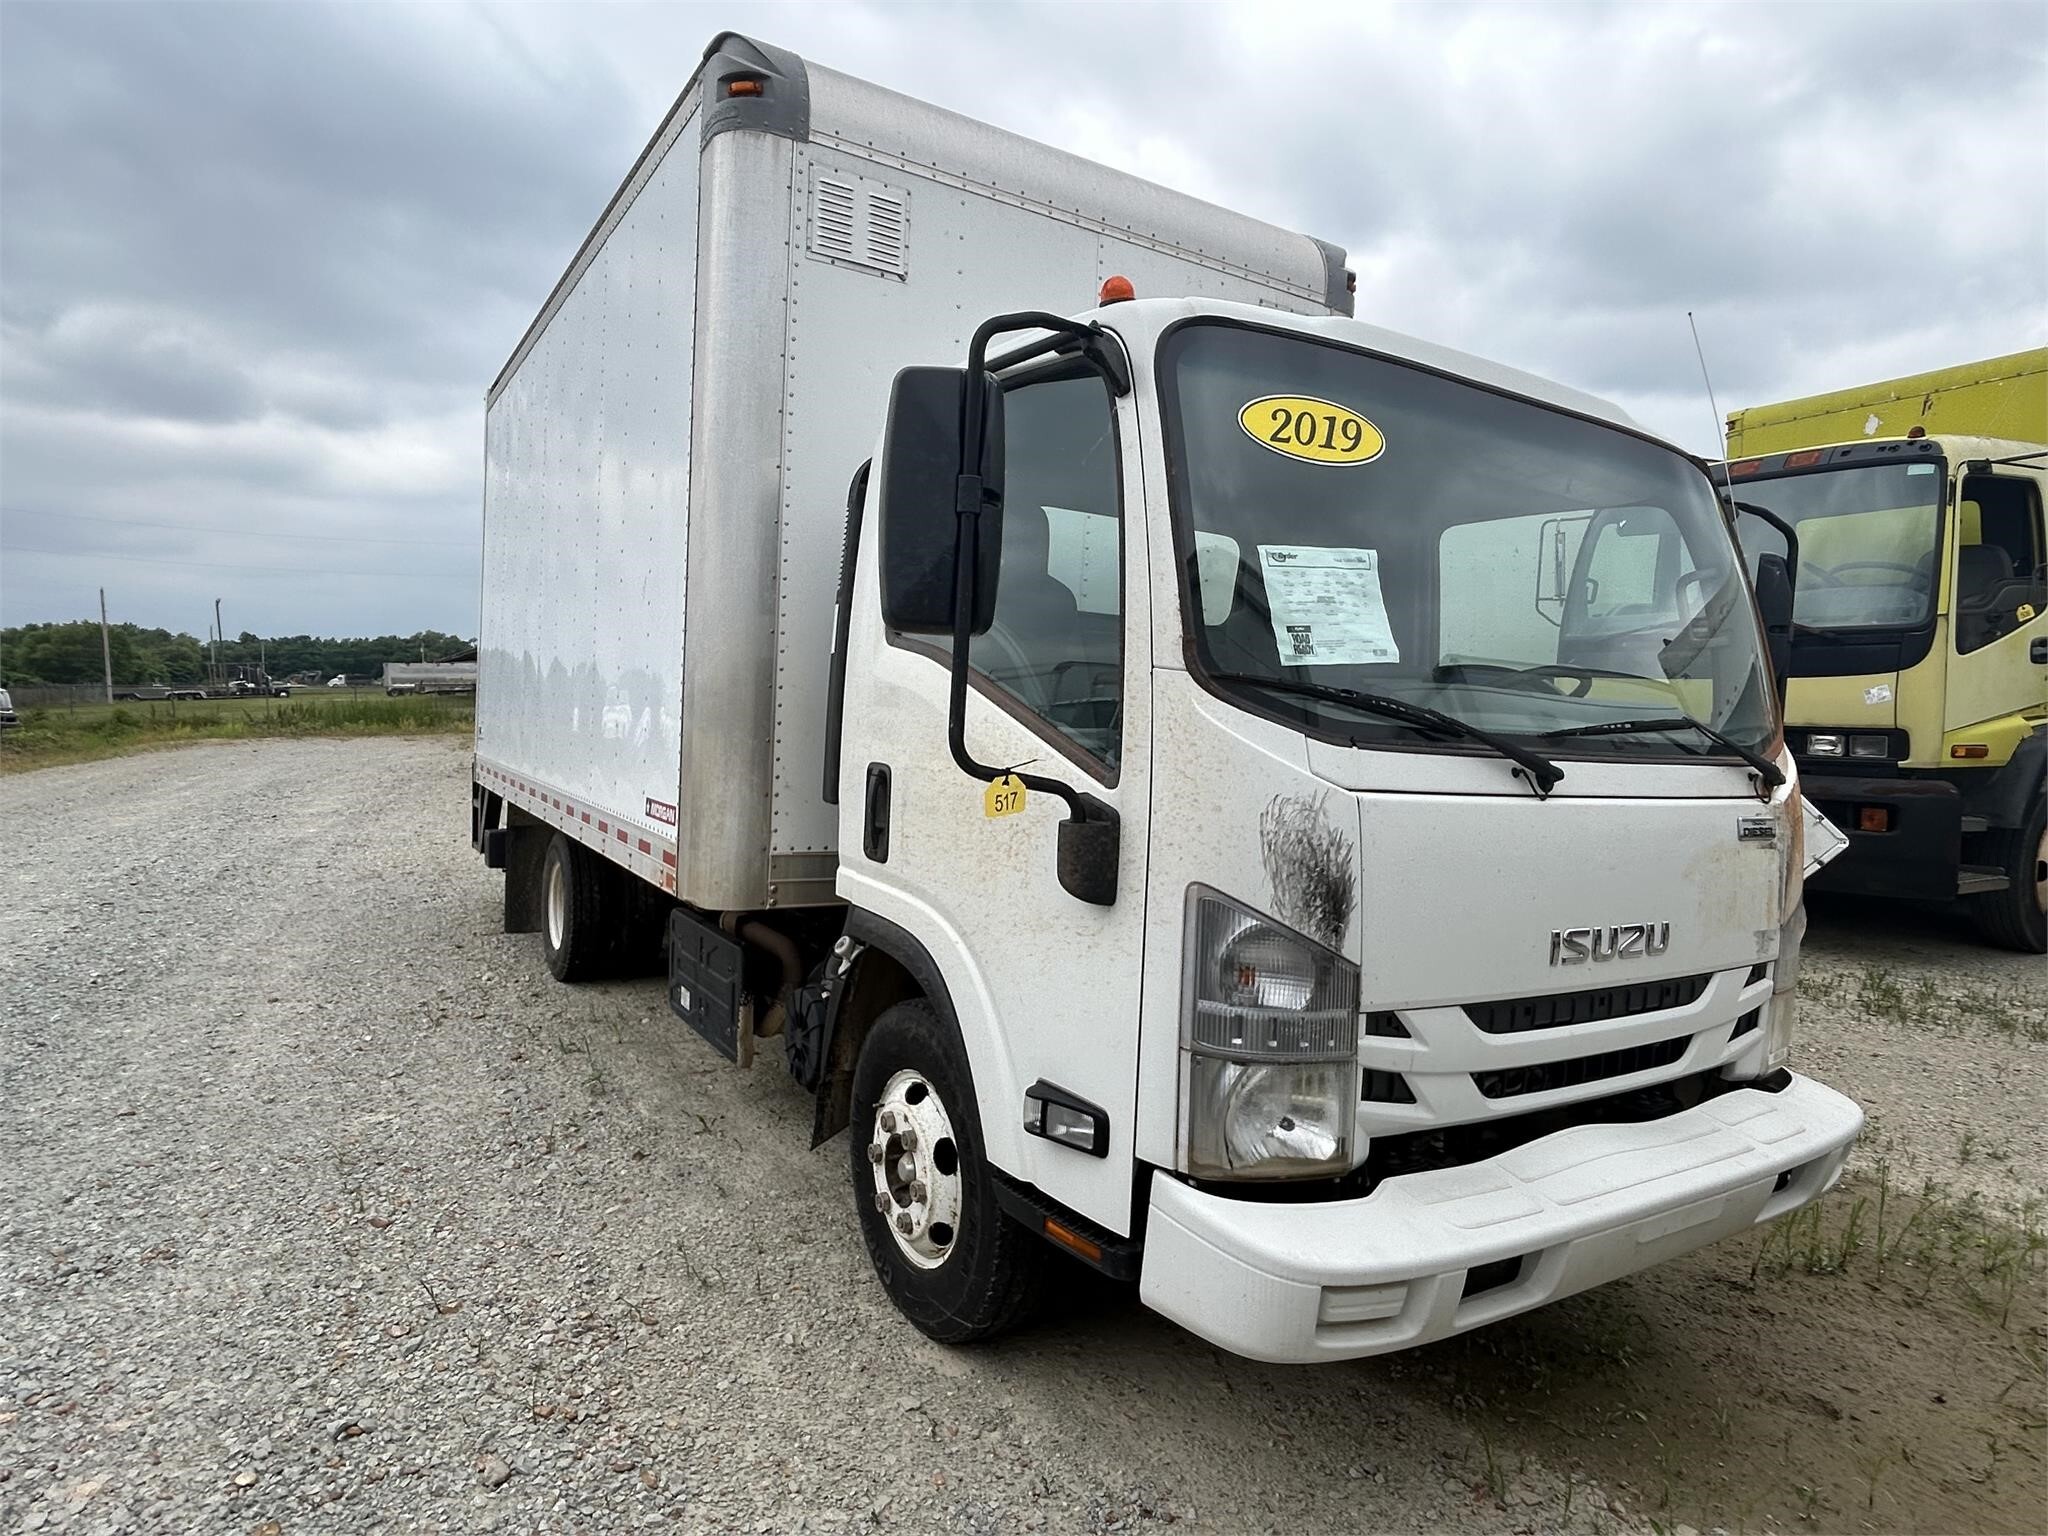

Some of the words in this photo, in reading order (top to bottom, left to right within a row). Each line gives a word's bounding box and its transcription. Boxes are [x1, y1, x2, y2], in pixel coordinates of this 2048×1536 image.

[1269, 408, 1363, 453] 2019
[994, 791, 1018, 812] 517
[1549, 920, 1670, 967] ISUZU
